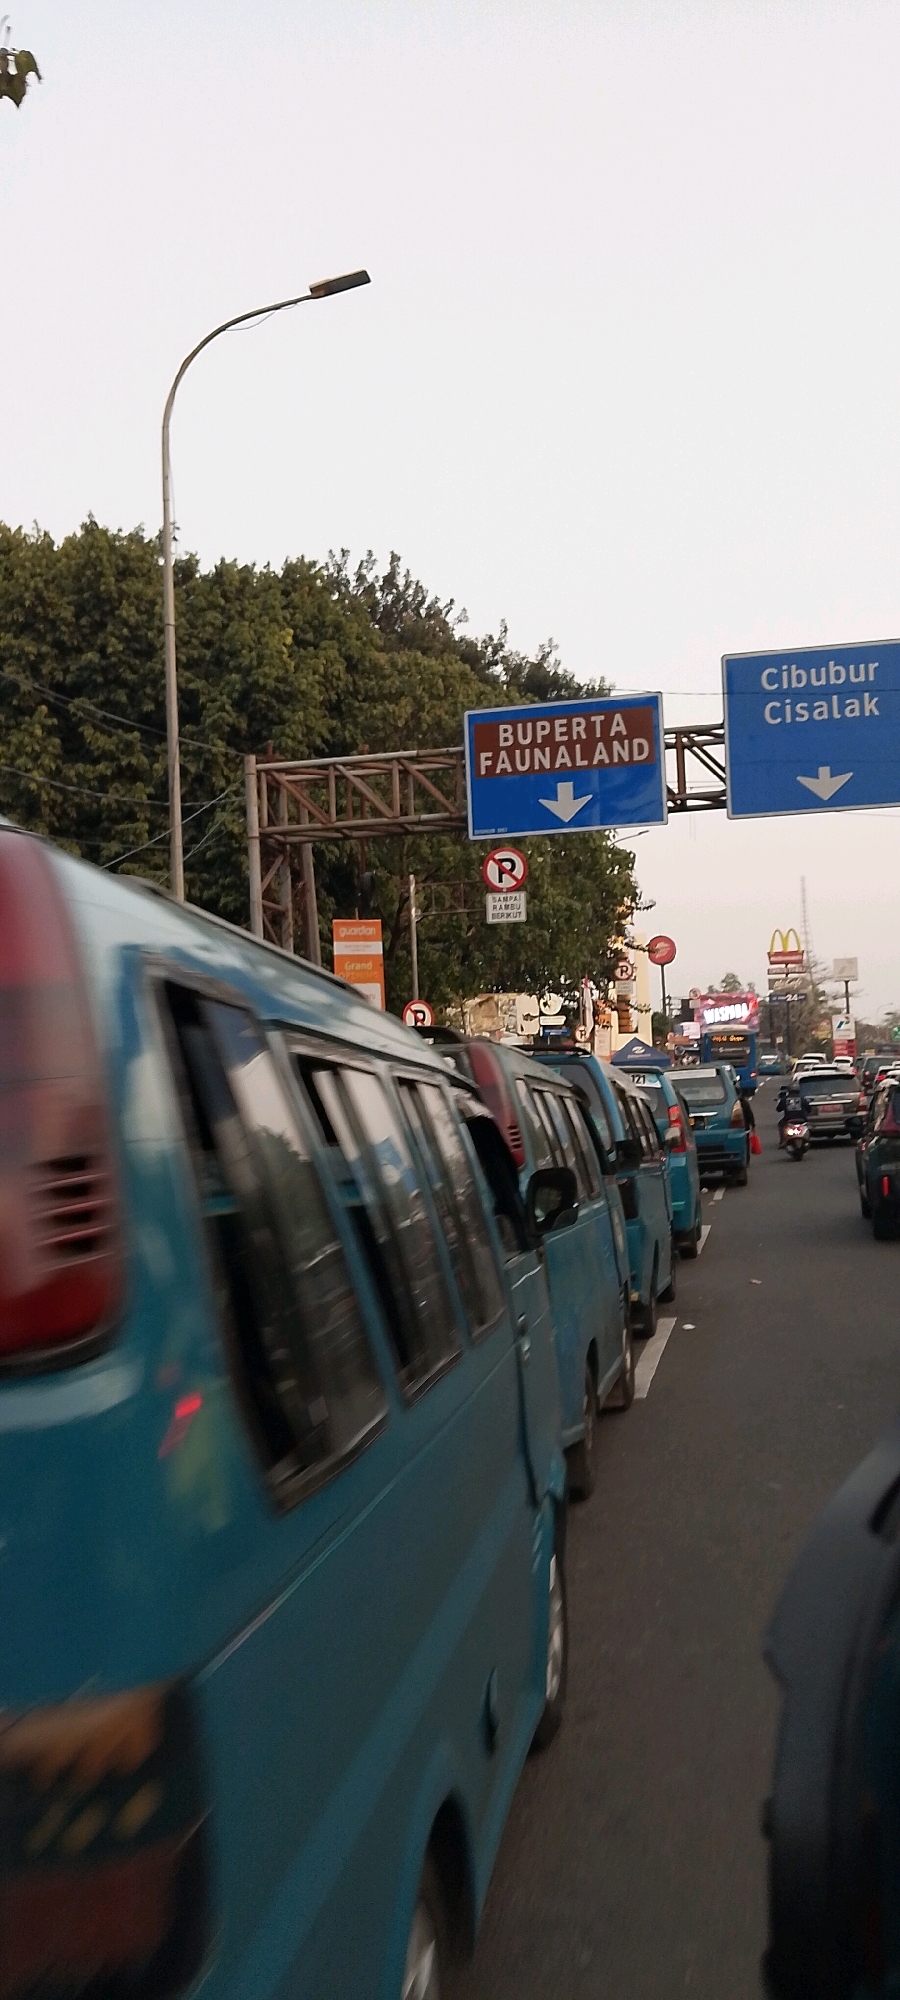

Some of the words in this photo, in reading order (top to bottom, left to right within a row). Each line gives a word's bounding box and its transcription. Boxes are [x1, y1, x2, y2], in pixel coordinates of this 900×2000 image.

[761, 660, 880, 691] Cibubur
[764, 692, 880, 725] Cisalak
[498, 713, 628, 748] BUPERTA
[479, 737, 650, 776] FAUNALAND
[491, 894, 522, 904] SAMPAI
[492, 903, 522, 912] RAMBU
[491, 911, 522, 920] BERIKUT
[339, 925, 377, 938] guardian
[344, 960, 374, 971] Grand
[630, 1074, 646, 1085] 121
